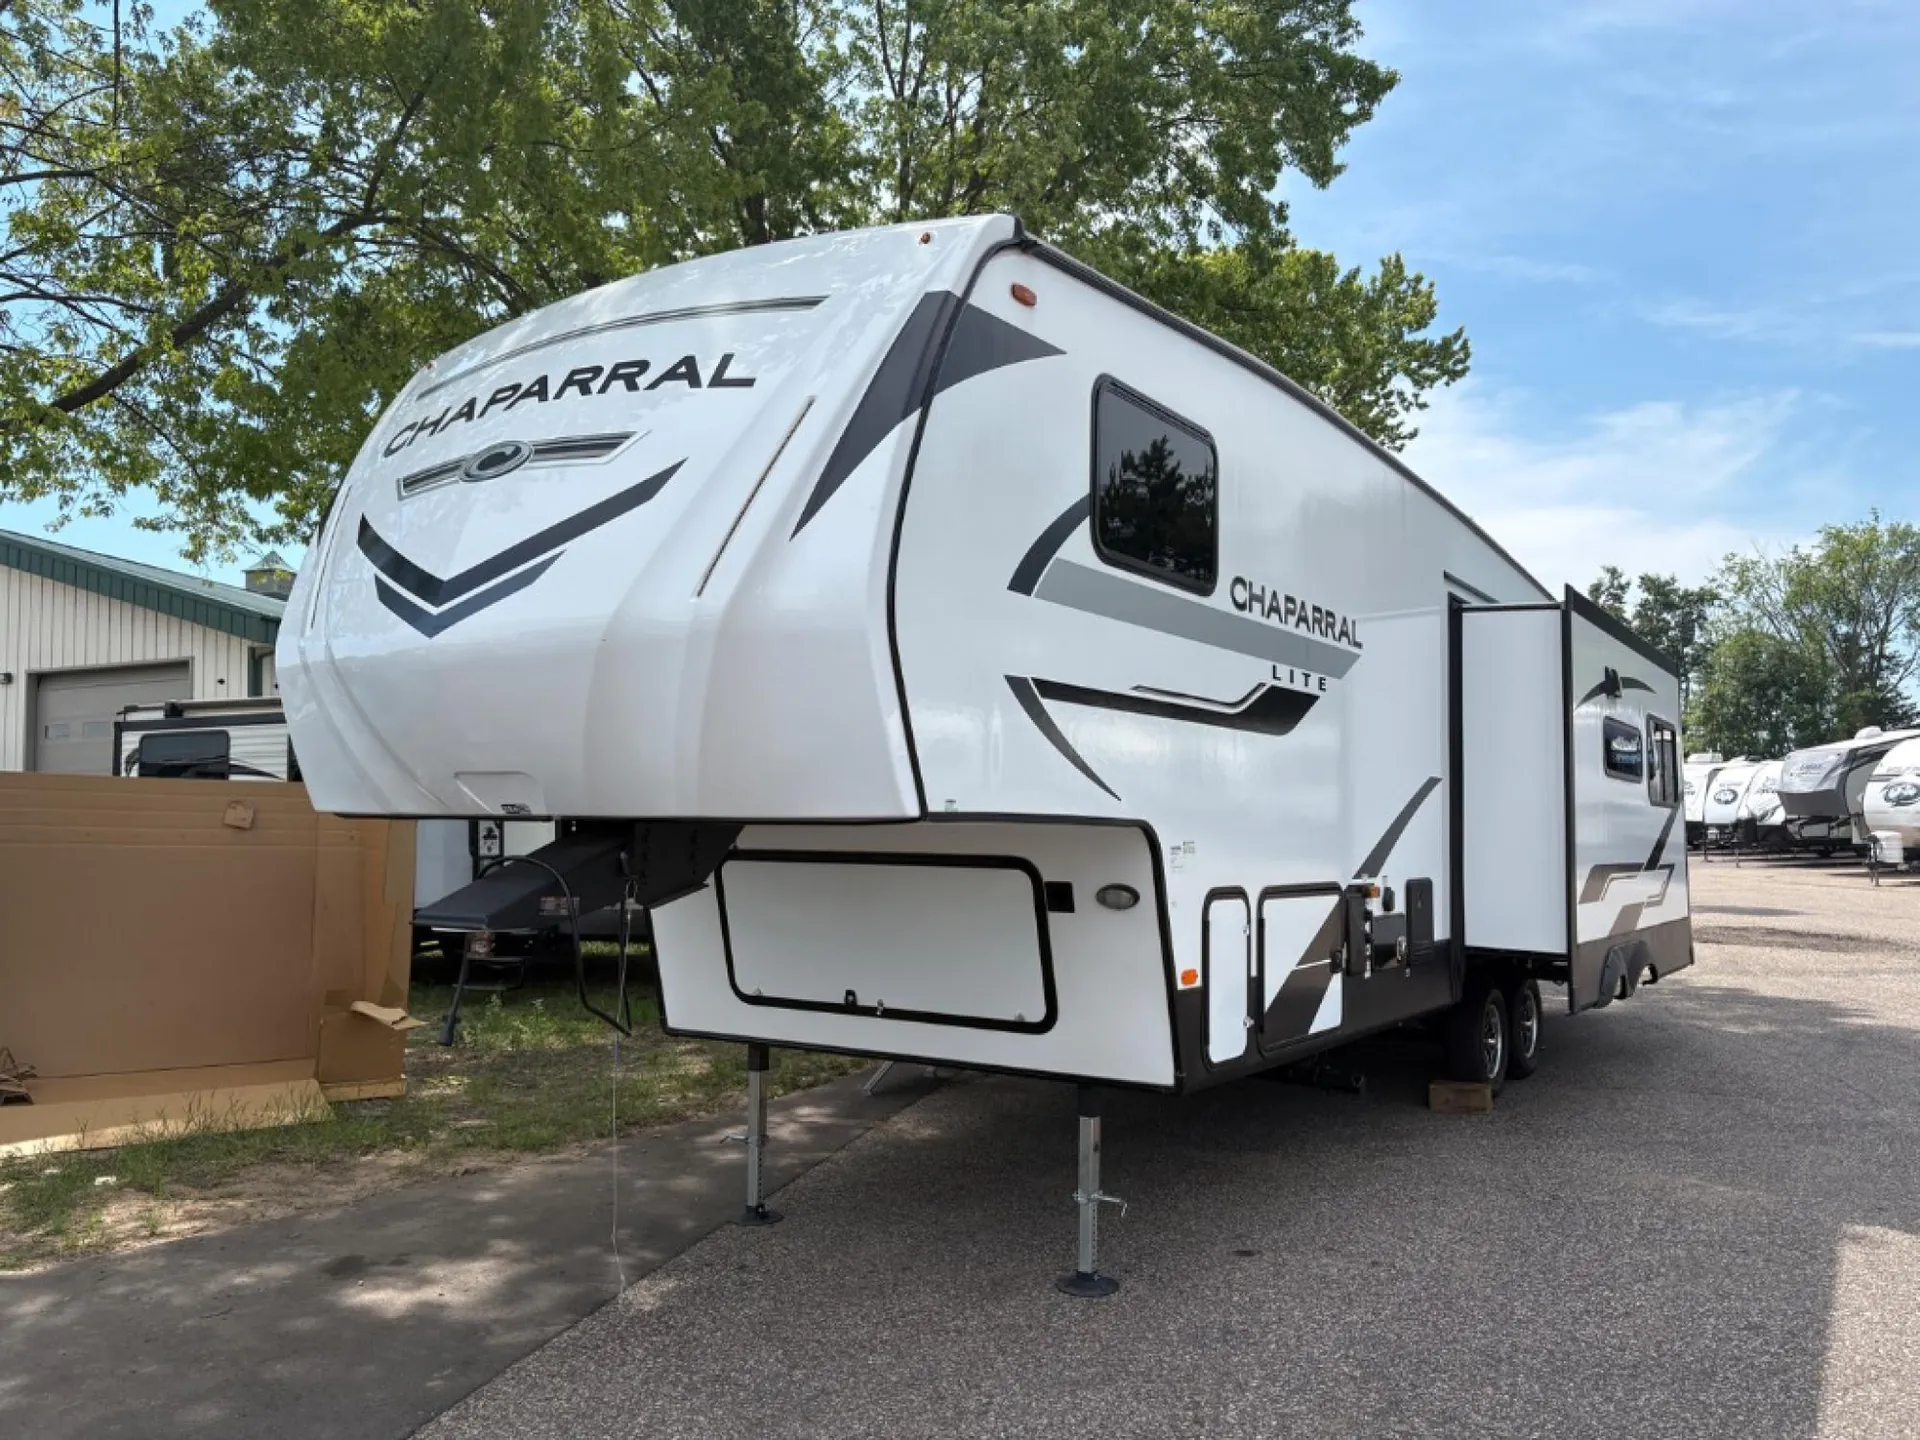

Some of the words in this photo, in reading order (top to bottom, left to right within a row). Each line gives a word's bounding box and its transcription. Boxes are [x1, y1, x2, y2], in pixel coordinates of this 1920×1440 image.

[383, 352, 756, 458] CHAPARRAL
[1230, 575, 1364, 649] CHAPARRAL
[1272, 664, 1327, 692] LITE
